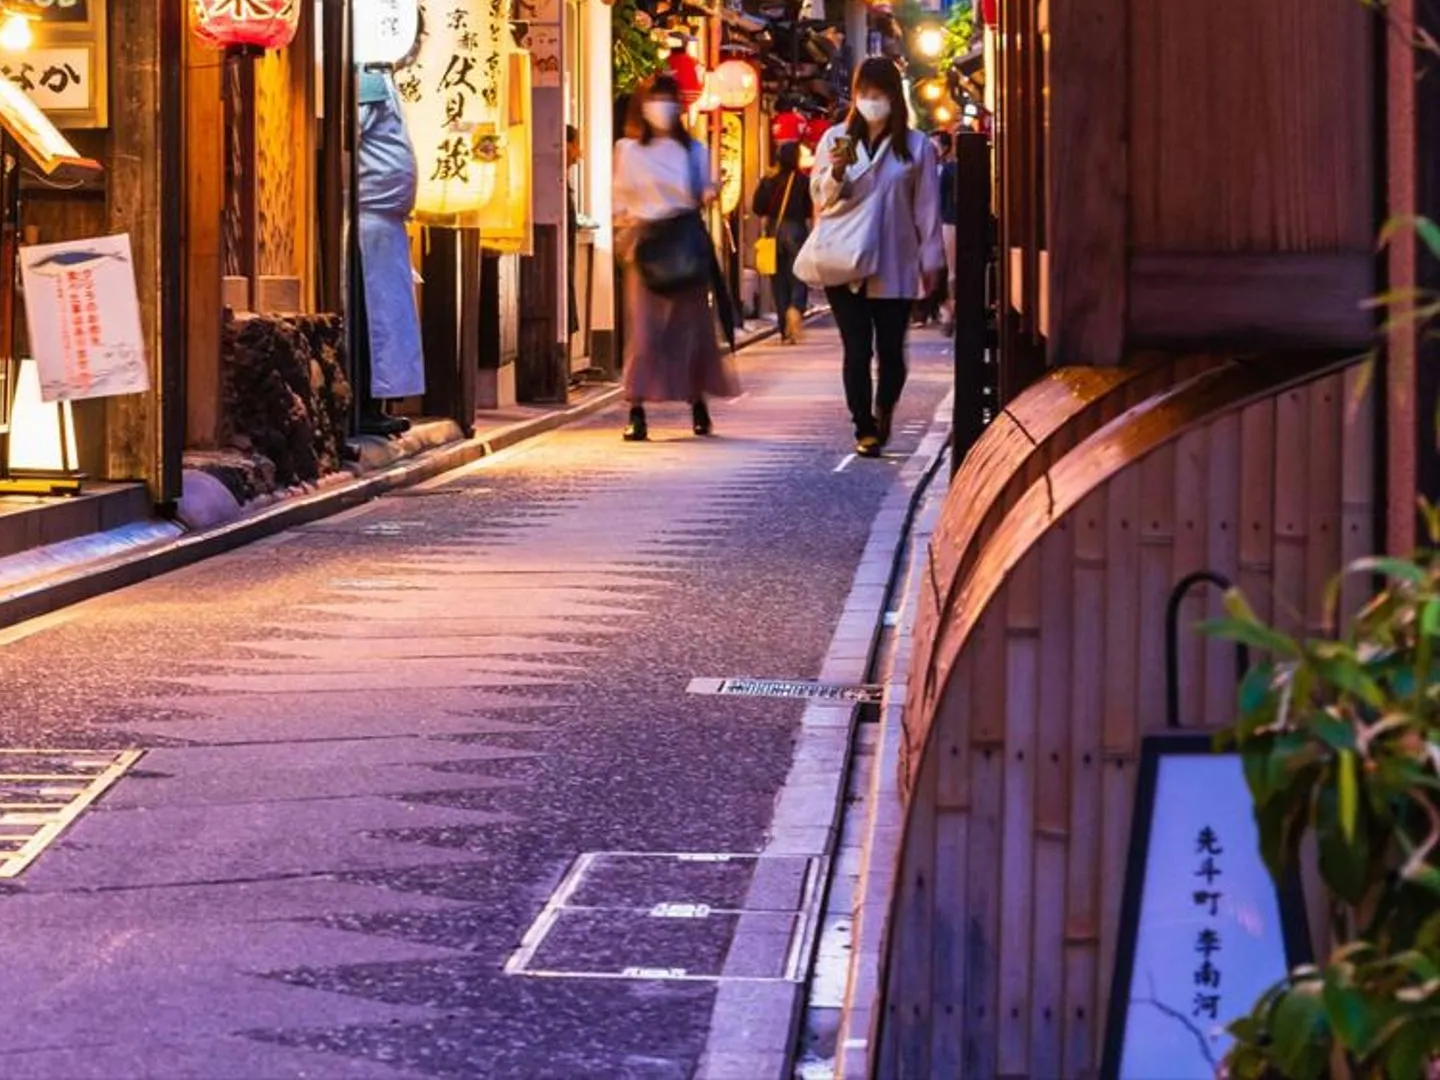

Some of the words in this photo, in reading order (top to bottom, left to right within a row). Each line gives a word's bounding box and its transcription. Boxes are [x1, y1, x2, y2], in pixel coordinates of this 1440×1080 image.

[446, 8, 479, 51] 京都
[1192, 825, 1223, 917] 先斗町
